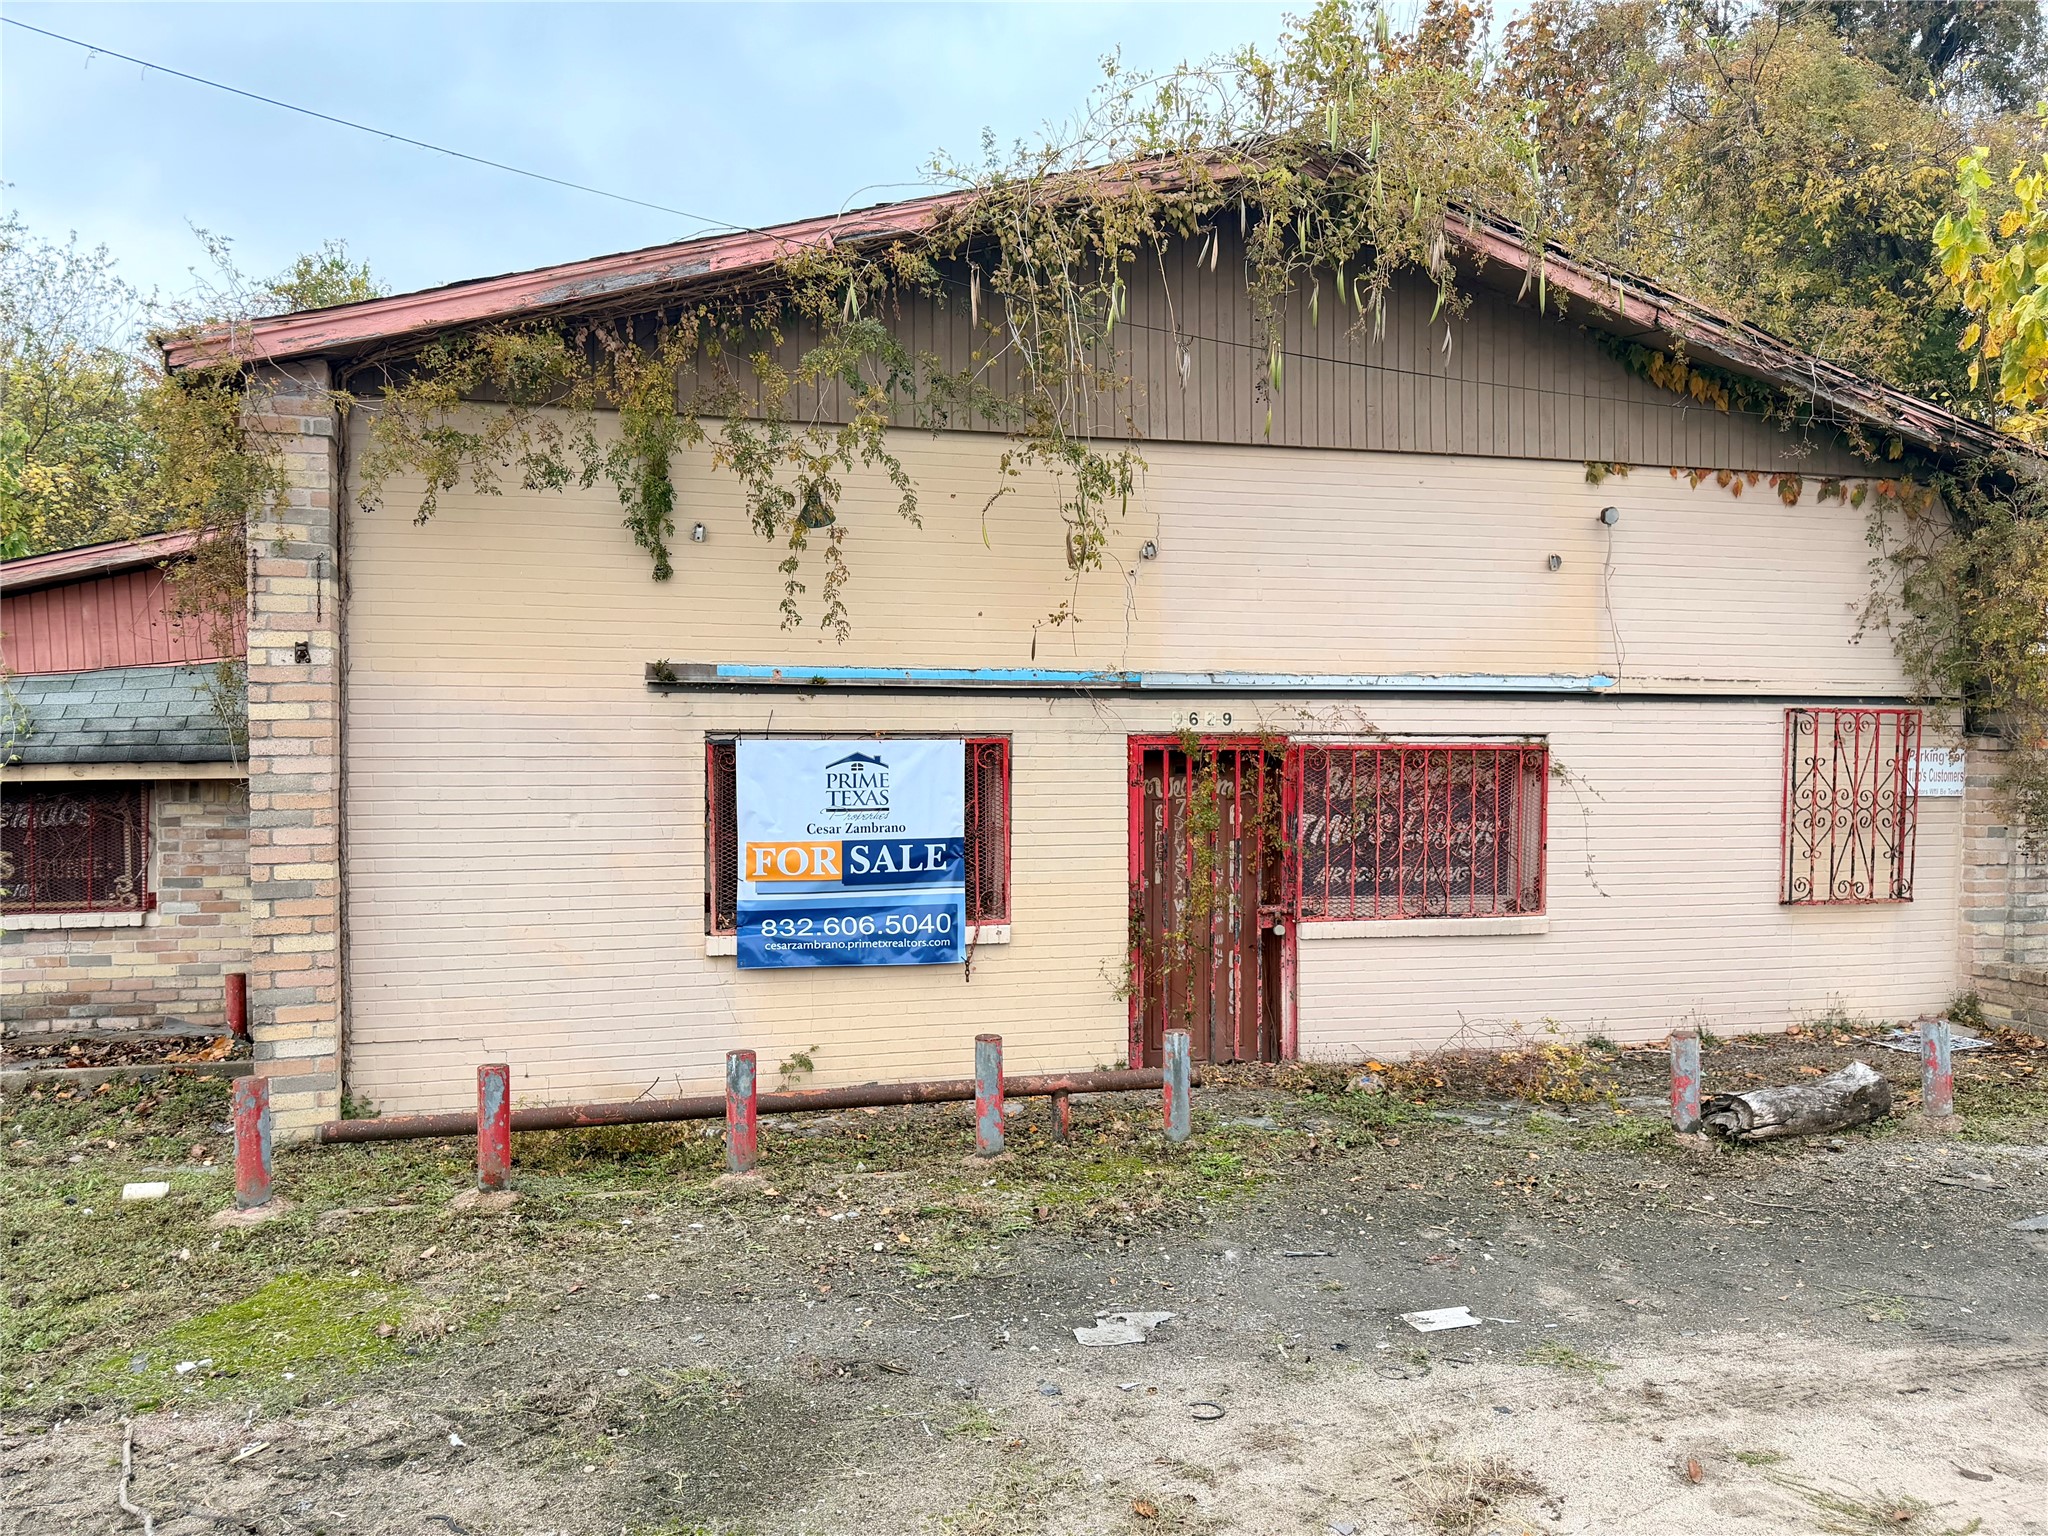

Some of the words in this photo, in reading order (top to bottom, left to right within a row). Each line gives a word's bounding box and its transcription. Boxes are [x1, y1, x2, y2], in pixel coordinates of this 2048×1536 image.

[825, 772, 890, 789] PRIME
[1928, 768, 1964, 782] Customers
[825, 789, 890, 807] TEXAS
[806, 823, 842, 835] Cesar
[845, 822, 906, 834] Zambrano
[752, 846, 840, 876] FOR
[850, 843, 948, 875] SALE
[761, 913, 952, 938] 832.606.5040
[764, 938, 951, 951] cesarzambrano.primetxrealtors.com
